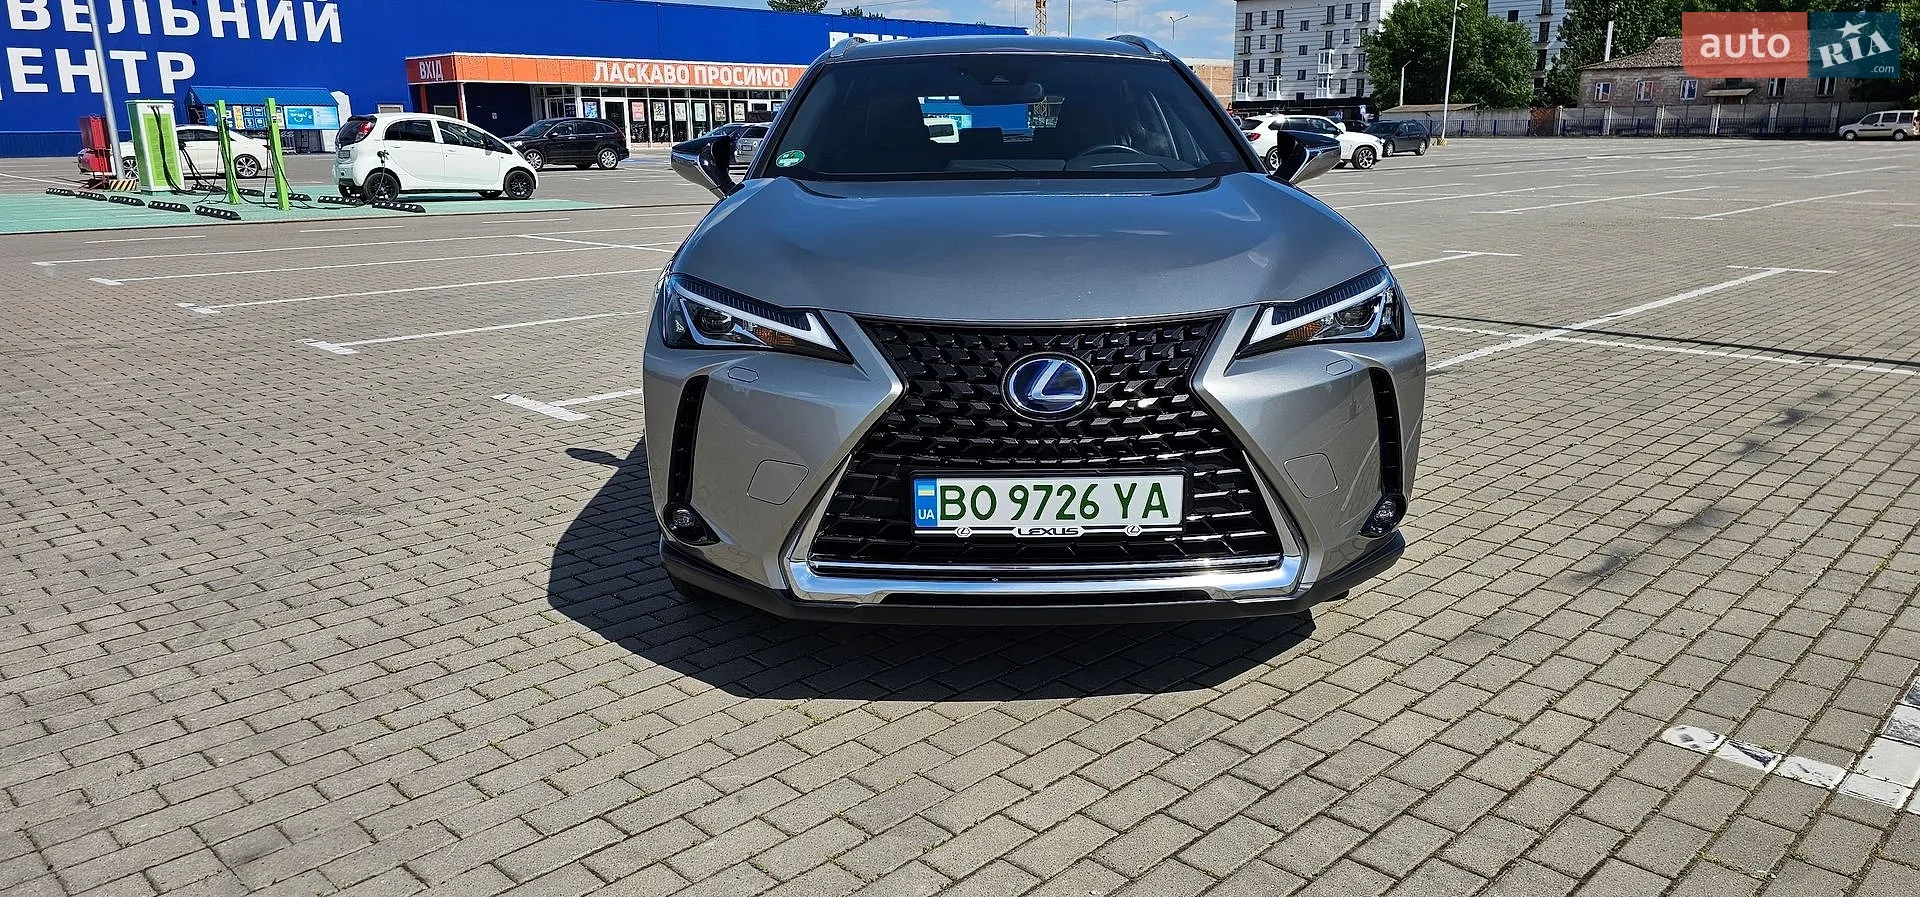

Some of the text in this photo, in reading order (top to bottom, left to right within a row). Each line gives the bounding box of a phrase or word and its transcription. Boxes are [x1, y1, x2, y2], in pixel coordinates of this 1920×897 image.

[7, 0, 342, 43] ВЕЛЬНИЙ
[0, 47, 196, 100] ЕНТР
[419, 60, 444, 81] ВХІД
[593, 61, 789, 87] ЛАСКАВО ПРОСИМО!
[918, 509, 935, 520] UA
[940, 482, 1169, 521] BO 9726 YA
[1017, 527, 1079, 536] LEXUS
